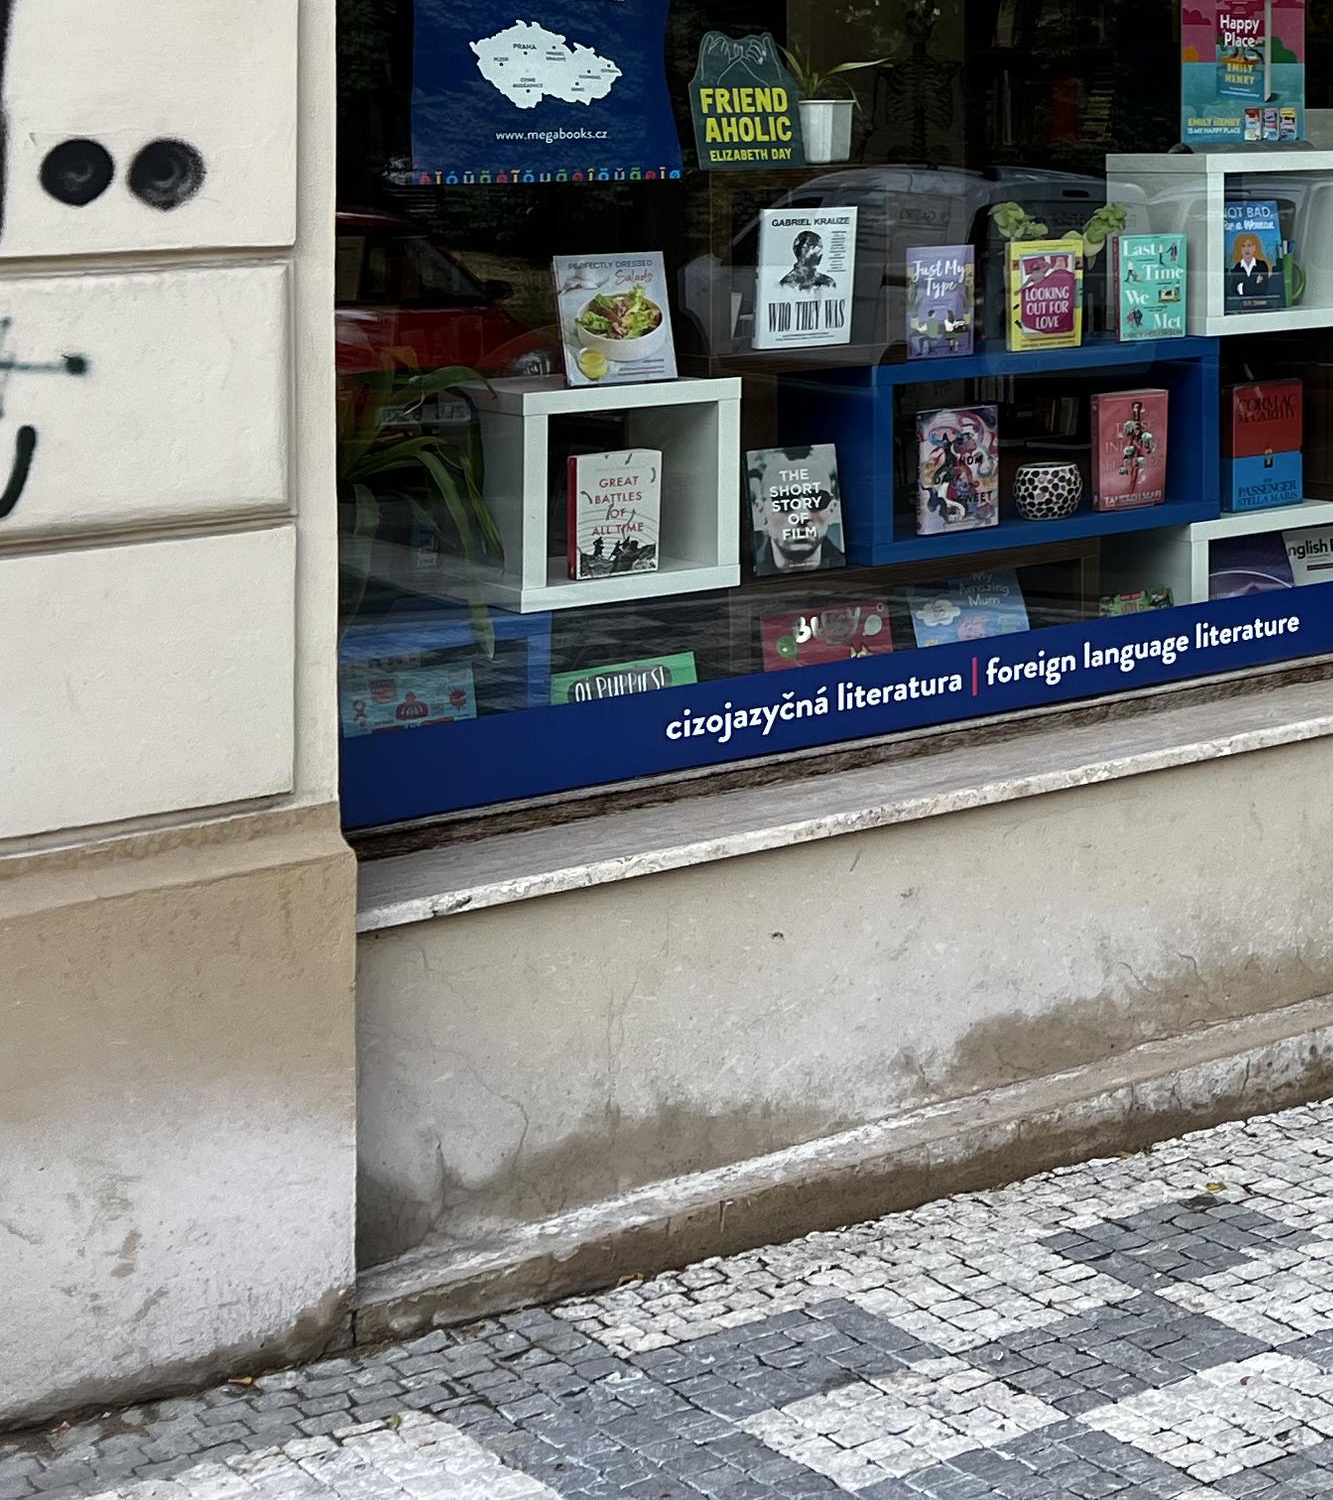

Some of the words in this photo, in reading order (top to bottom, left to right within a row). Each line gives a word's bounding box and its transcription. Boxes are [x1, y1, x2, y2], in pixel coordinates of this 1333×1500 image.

[1220, 14, 1260, 34] Happy
[1224, 32, 1255, 47] Place
[700, 87, 788, 114] FRIEND
[495, 127, 608, 143] www.megabooks.cz
[705, 116, 793, 143] AHOLIC
[709, 148, 768, 162] ELIZABETH
[771, 148, 792, 160] DAY
[771, 218, 812, 227] GABRIEL
[814, 216, 850, 226] KRAUZE
[568, 260, 613, 270] PERFECTLY
[911, 260, 944, 283] Just
[944, 259, 966, 283] My
[1141, 263, 1185, 280] Time
[924, 277, 958, 299] Type
[1025, 286, 1070, 301] LOOKING
[1125, 289, 1150, 305] We
[1026, 302, 1047, 316] OUT
[1049, 300, 1070, 313] FOR
[1035, 315, 1061, 330] LOVE
[1153, 313, 1181, 329] Met
[599, 476, 639, 488] GREAT
[779, 468, 809, 482] THE
[769, 482, 821, 498] SHORT
[1238, 480, 1297, 497] PASSENGER
[595, 492, 643, 505] BATTLES
[772, 496, 822, 512] STORY
[610, 508, 625, 519] OF
[788, 512, 809, 525] OF
[592, 525, 611, 536] ALL
[782, 526, 817, 540] FILM
[1288, 541, 1328, 560] nglish
[968, 594, 1001, 607] Mum
[665, 682, 829, 744] cizojazyčná
[837, 667, 963, 713] literatura
[985, 639, 1077, 687] foreign
[1083, 631, 1190, 676] language
[1194, 611, 1301, 650] literature
